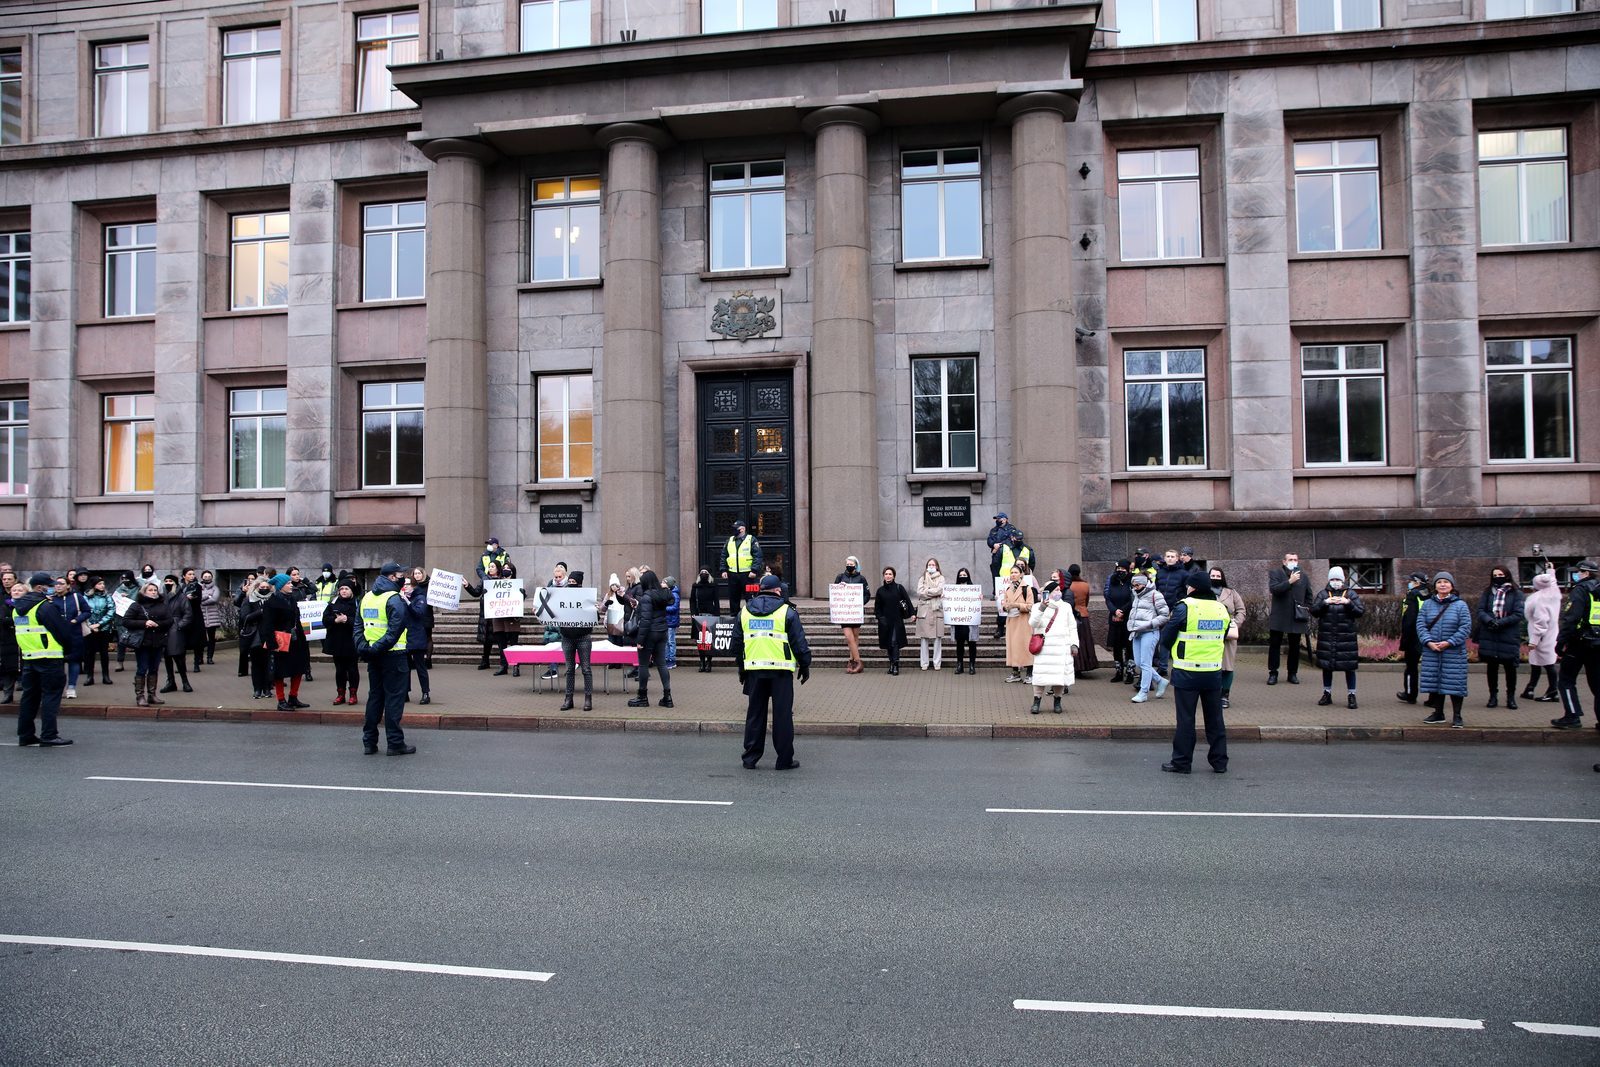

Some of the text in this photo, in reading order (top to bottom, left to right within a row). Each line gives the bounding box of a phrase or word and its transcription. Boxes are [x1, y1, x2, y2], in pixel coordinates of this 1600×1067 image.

[437, 572, 454, 581] Mums
[493, 580, 512, 589] Mēs
[430, 589, 456, 599] papildus
[489, 599, 520, 608] gribam
[750, 620, 773, 629] POLICIJA
